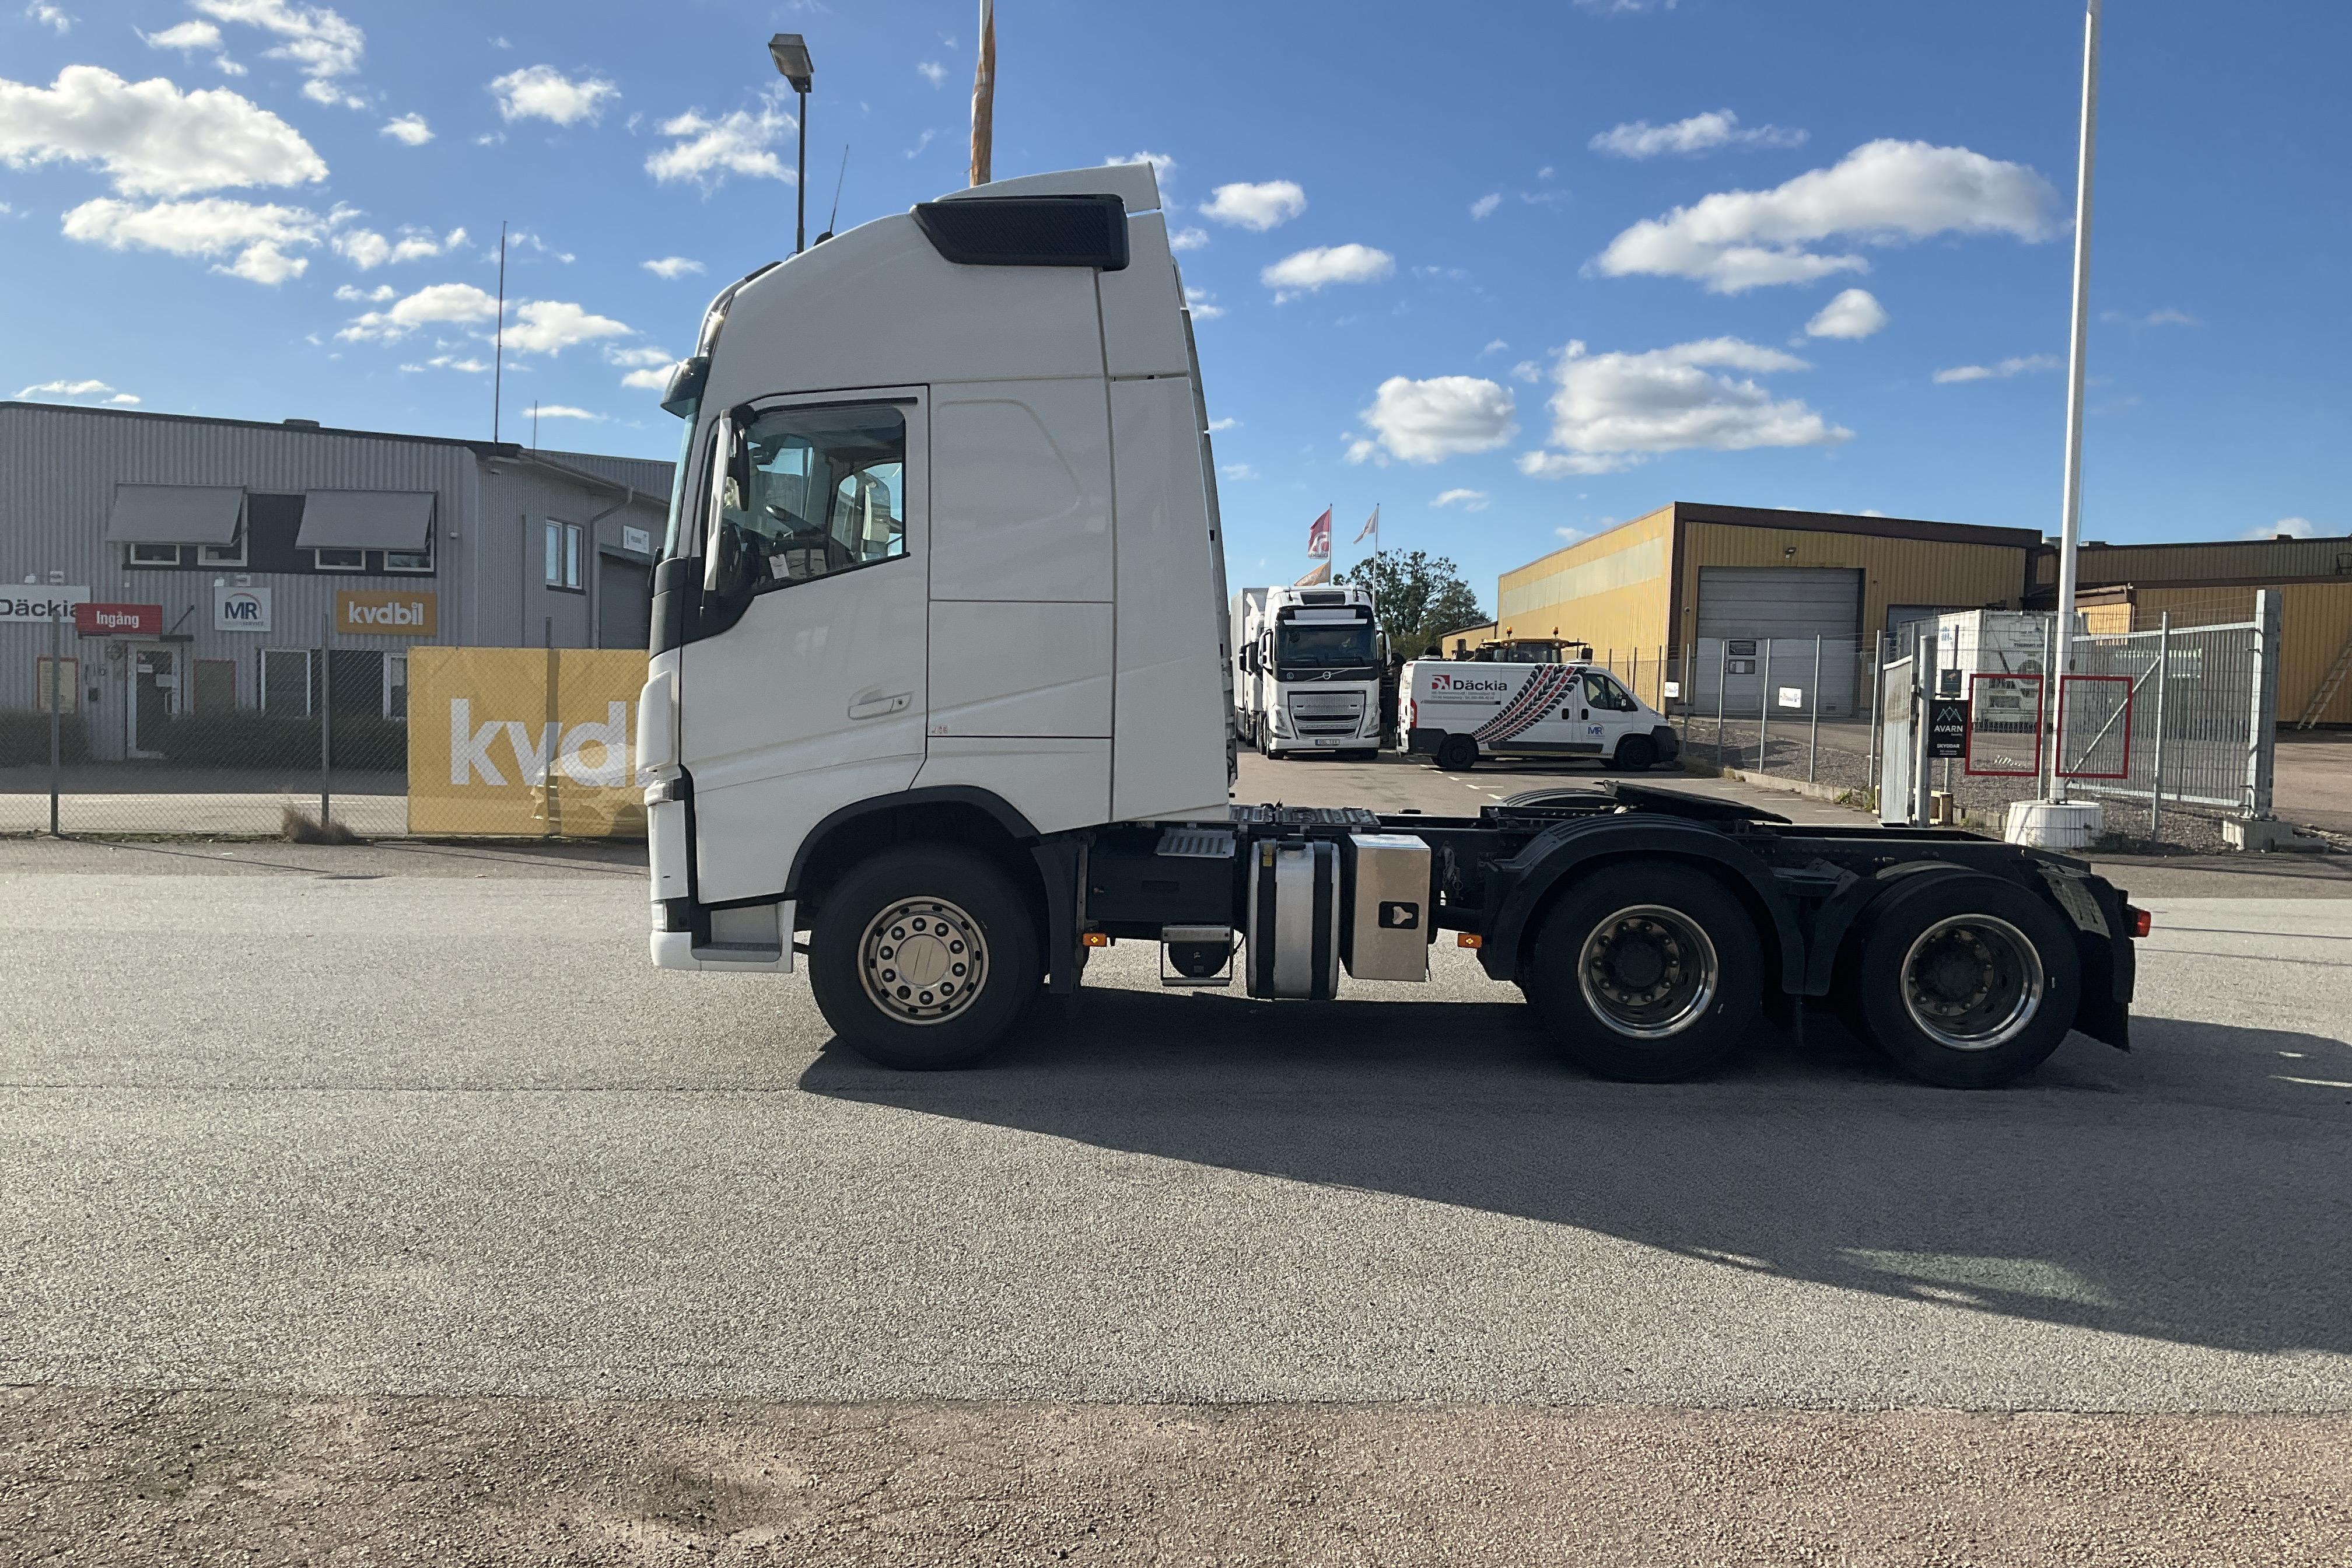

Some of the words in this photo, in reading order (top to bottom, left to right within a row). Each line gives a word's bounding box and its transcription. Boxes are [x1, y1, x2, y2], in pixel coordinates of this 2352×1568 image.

[96, 610, 140, 628] Ingång
[225, 601, 258, 620] MR
[348, 601, 423, 625] kvdbil
[1453, 680, 1507, 691] Däckia
[1588, 727, 1603, 735] MR
[1934, 724, 1963, 733] AVARN
[451, 698, 652, 788] kvd
